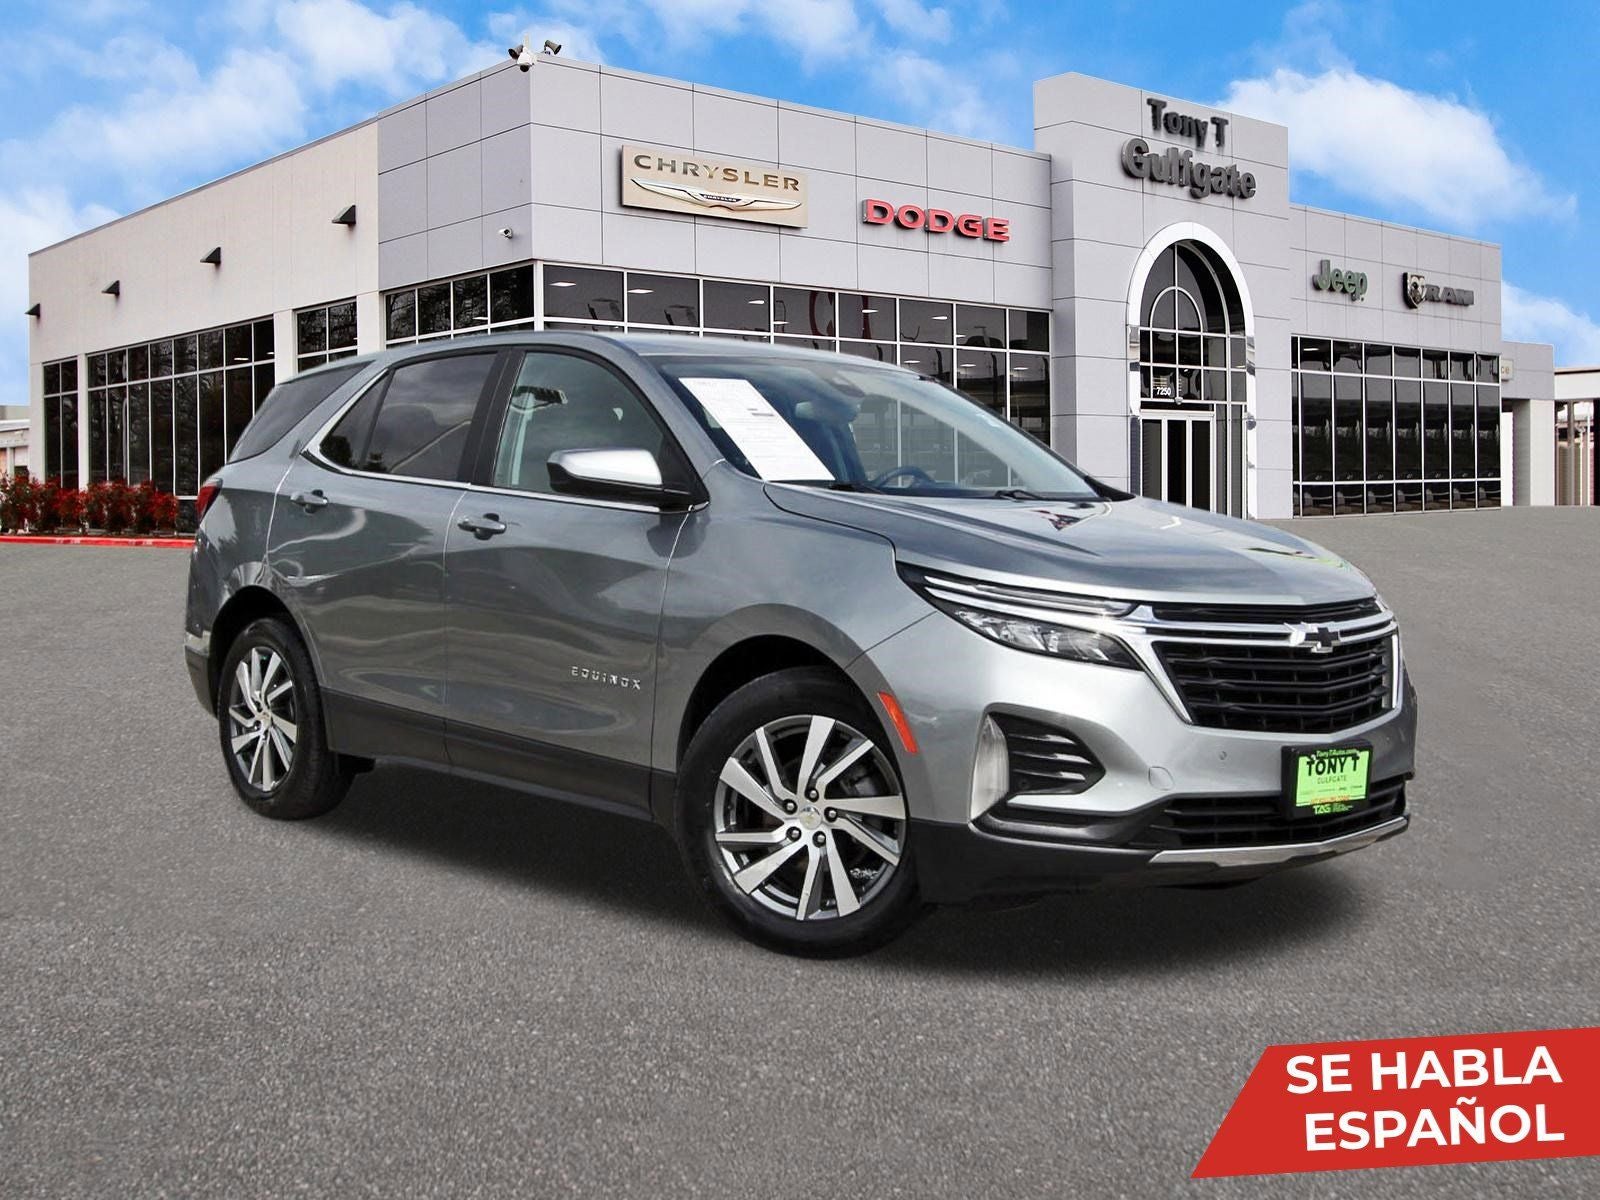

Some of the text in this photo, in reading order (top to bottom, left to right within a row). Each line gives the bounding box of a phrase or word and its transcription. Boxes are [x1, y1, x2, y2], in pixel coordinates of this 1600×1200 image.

[1146, 98, 1229, 147] Tony T
[634, 154, 799, 191] CHRYSLER
[1121, 138, 1256, 199] Gulfgate
[862, 198, 1010, 242] DODGE
[1312, 259, 1368, 302] Jeep
[1424, 284, 1475, 306] RAM
[1156, 387, 1171, 396] 7250
[571, 666, 641, 690] EQUINOX
[1306, 755, 1360, 776] TONY T
